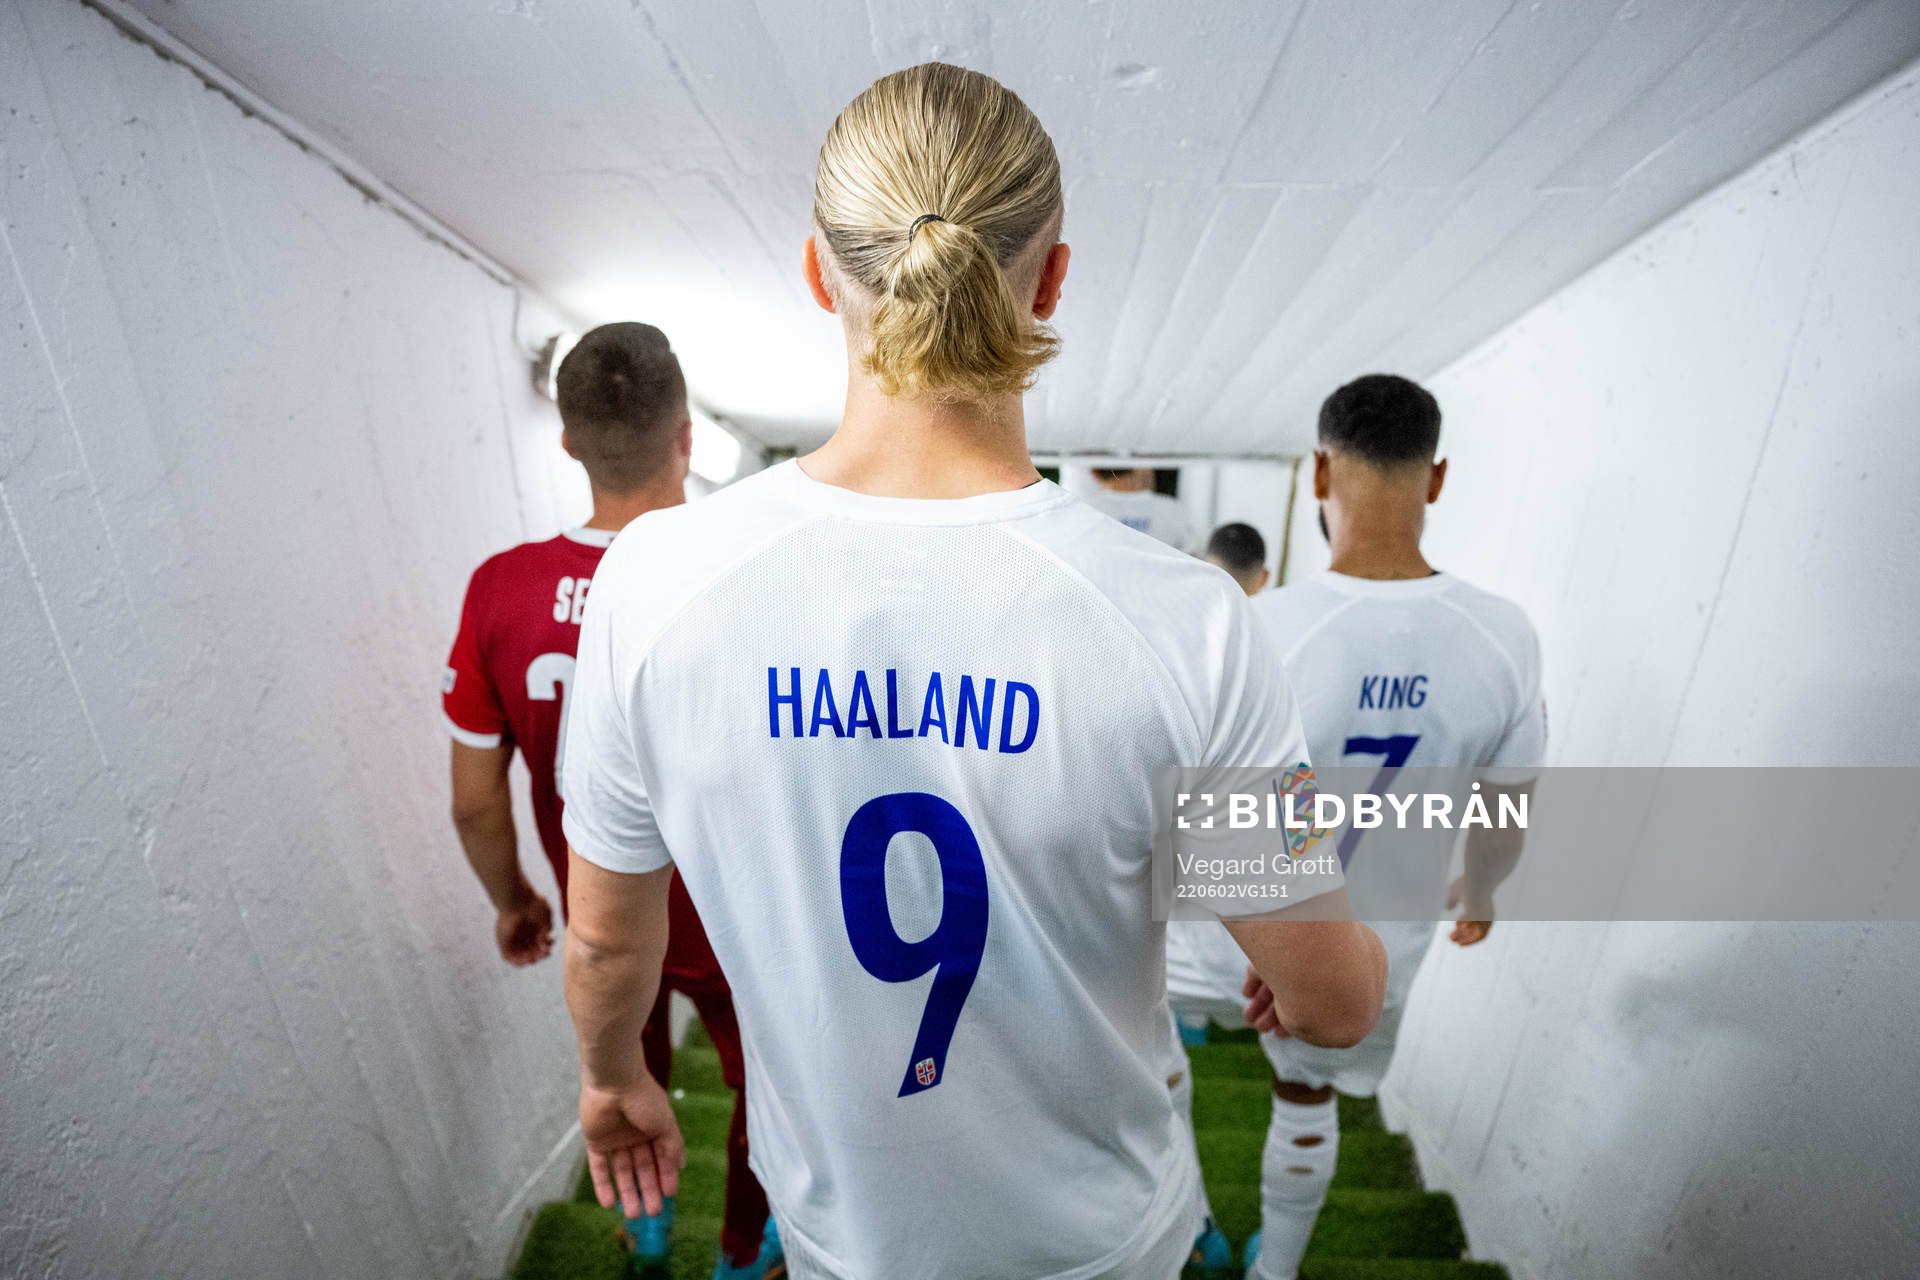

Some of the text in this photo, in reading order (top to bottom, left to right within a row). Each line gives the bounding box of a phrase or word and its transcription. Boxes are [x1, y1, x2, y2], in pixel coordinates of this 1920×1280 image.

[768, 667, 1040, 754] HAALAND
[1359, 674, 1429, 710] KING
[1340, 734, 1421, 875] 7
[840, 792, 989, 1098] 9
